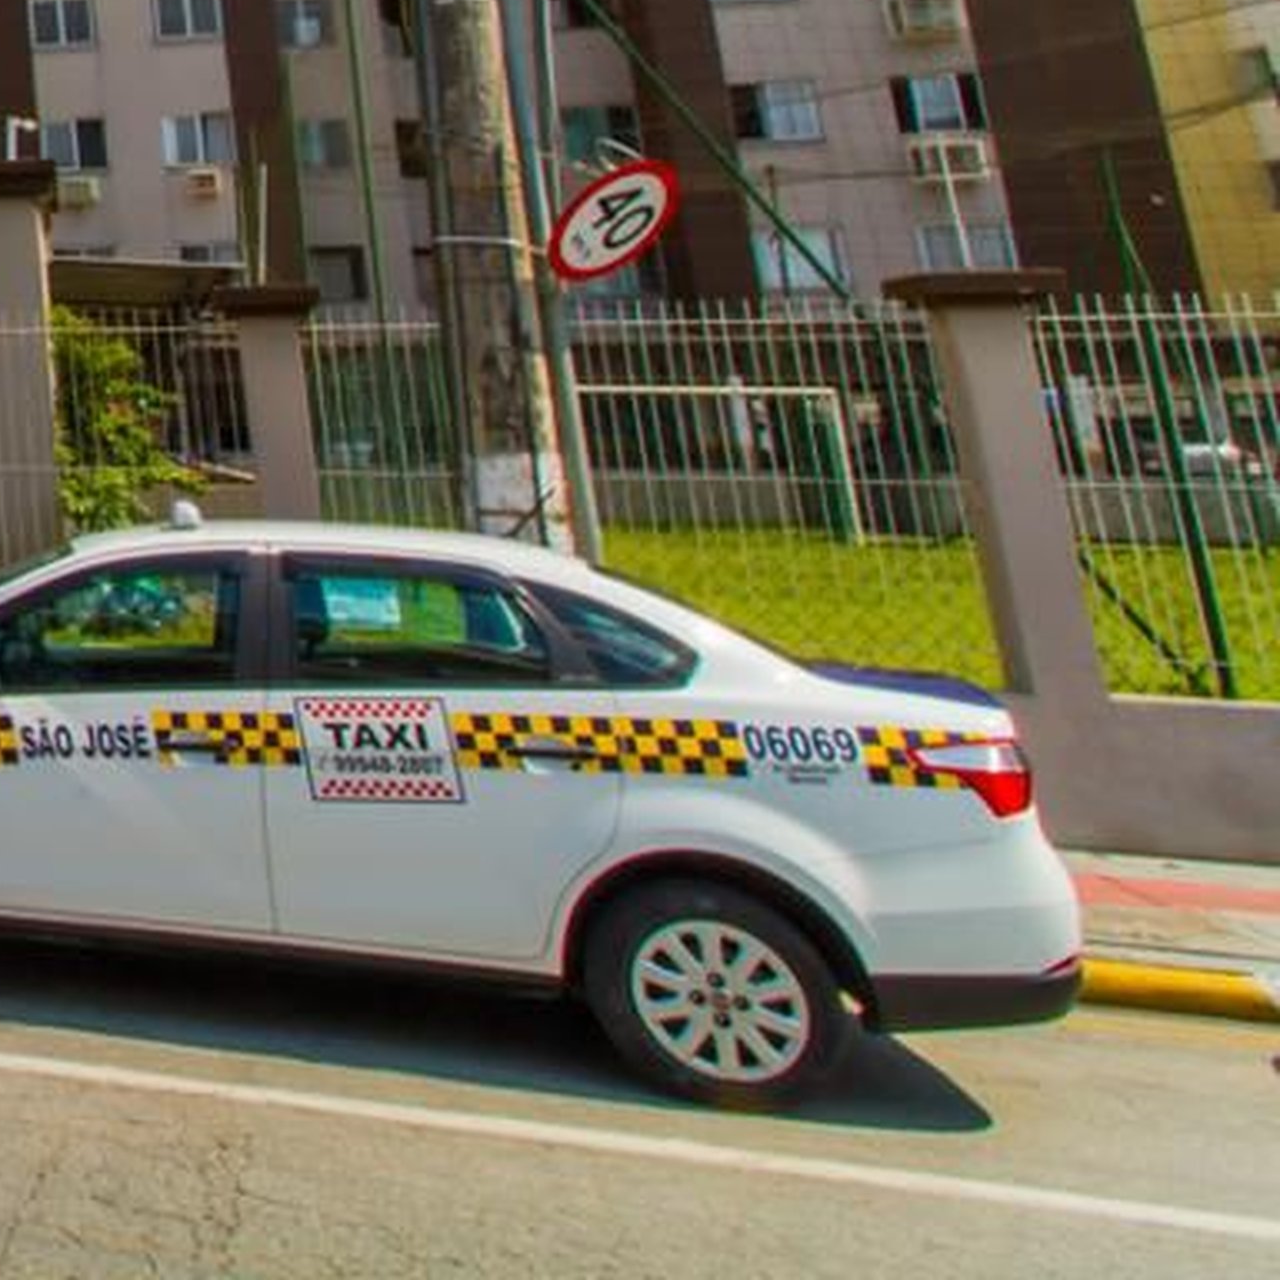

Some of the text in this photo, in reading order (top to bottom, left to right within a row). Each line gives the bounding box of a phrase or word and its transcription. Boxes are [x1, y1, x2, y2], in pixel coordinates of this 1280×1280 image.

[594, 186, 655, 250] 40
[21, 714, 152, 759] SÃO JOSÉ
[322, 722, 430, 751] TAXI
[743, 724, 859, 763] 06069
